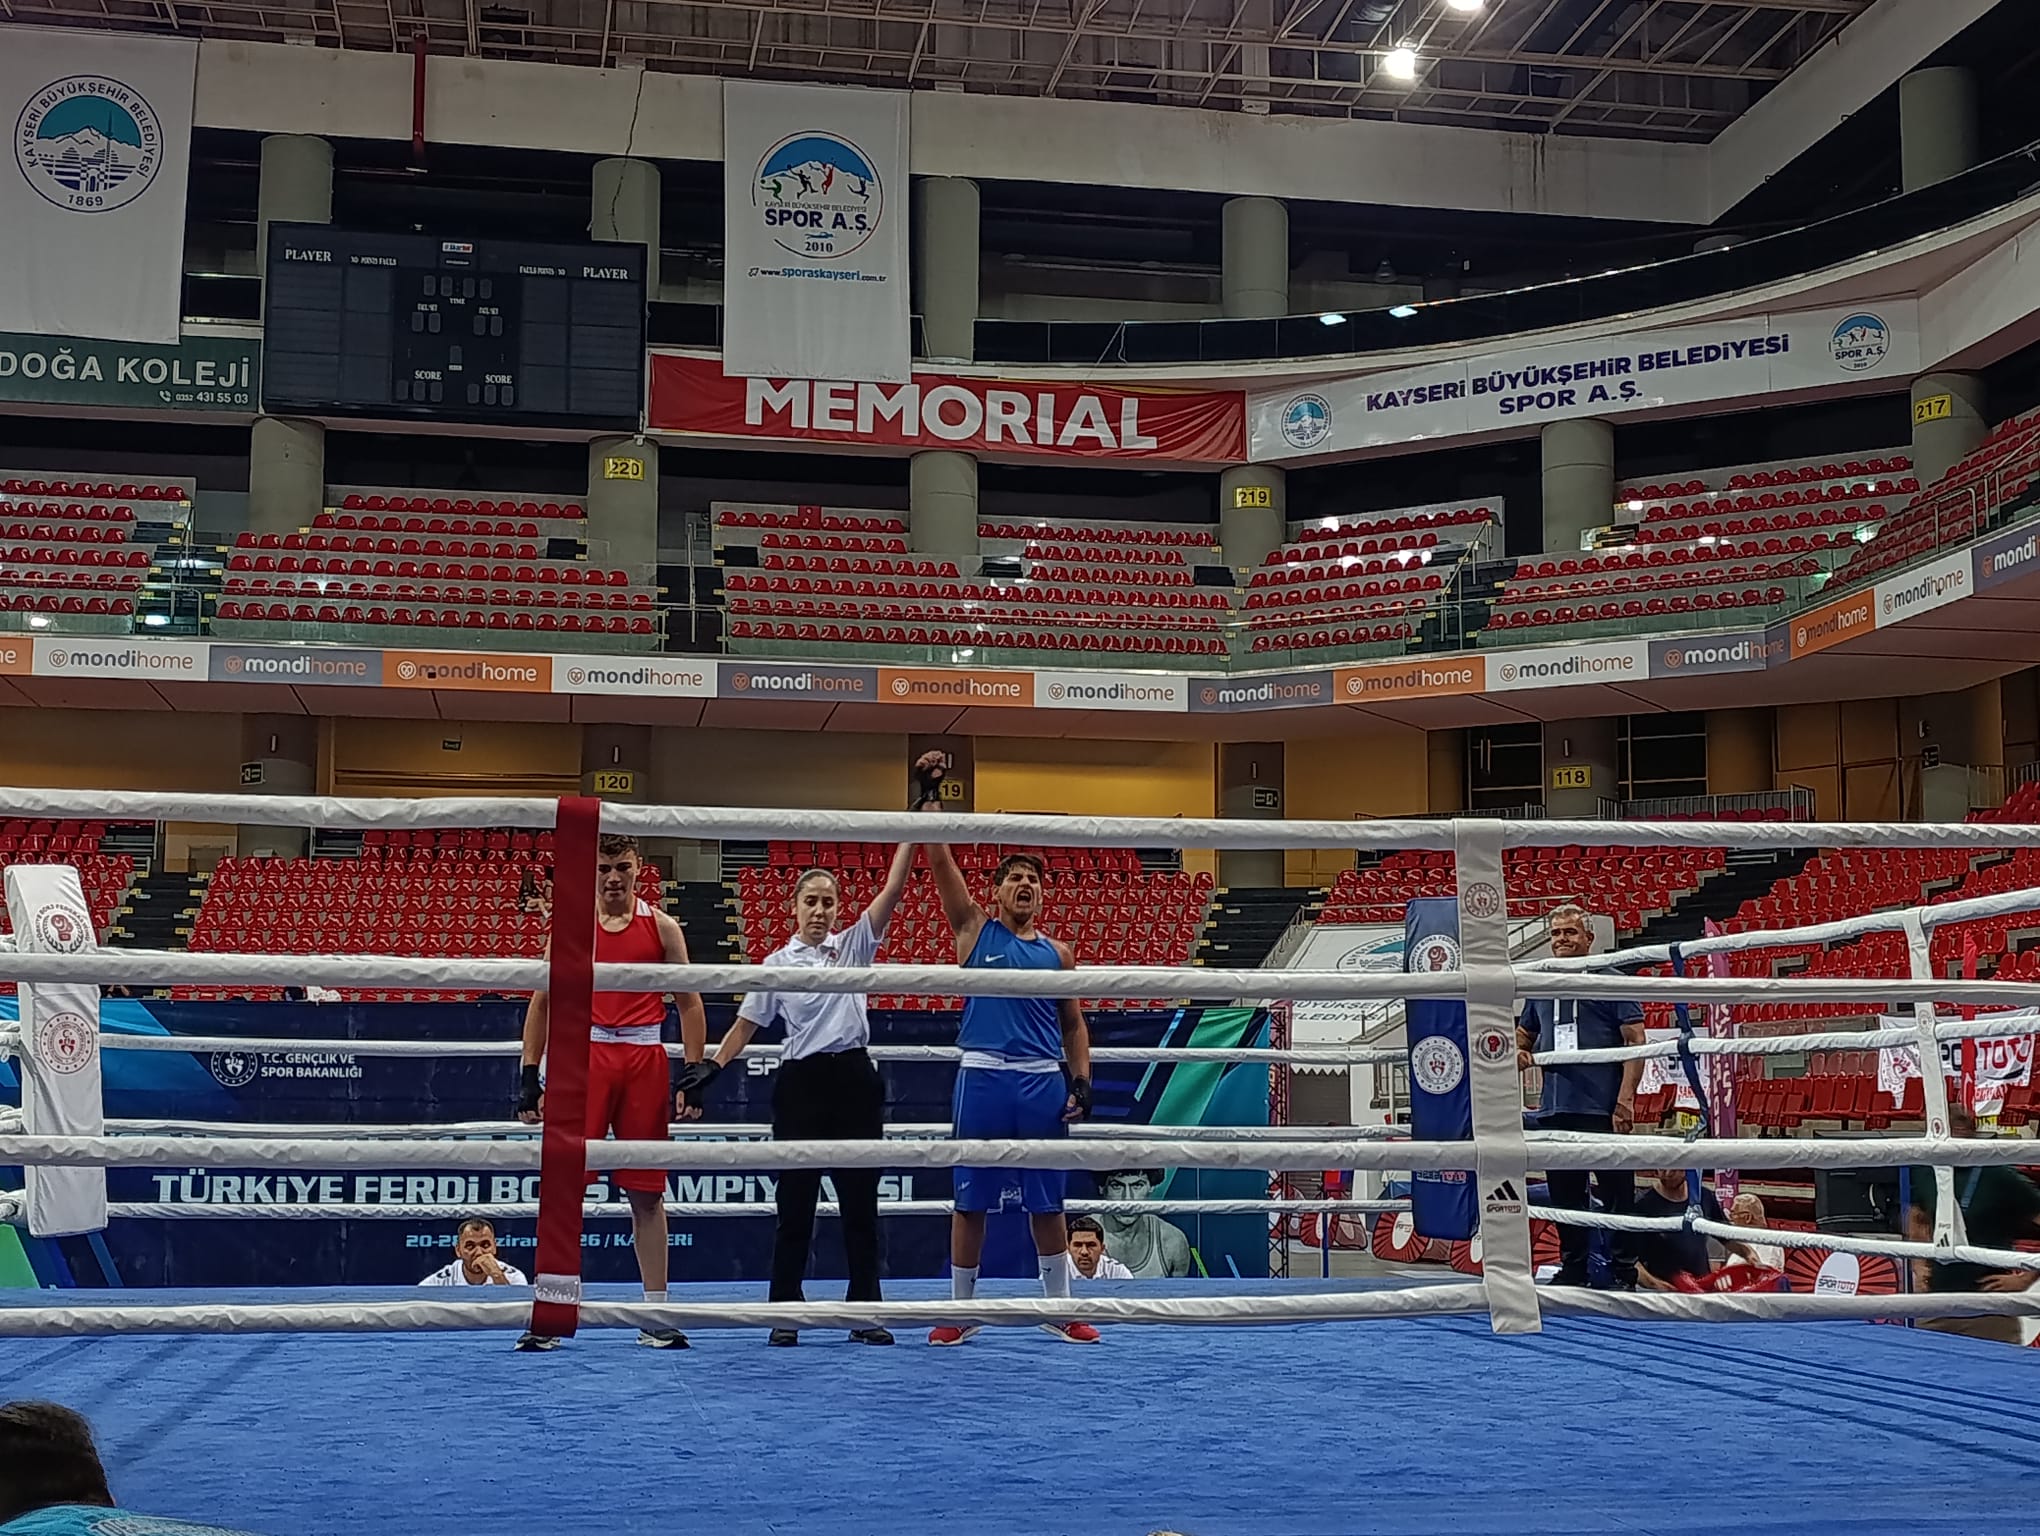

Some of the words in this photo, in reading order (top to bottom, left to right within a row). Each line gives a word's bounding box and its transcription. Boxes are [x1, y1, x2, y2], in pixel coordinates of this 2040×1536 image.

[23, 107, 42, 168] KAYSERİ
[40, 82, 129, 109] BÜYÜKŞEHİR
[130, 102, 157, 178] BELEDİYESİ
[68, 194, 104, 207] 1869
[765, 208, 823, 228] SPOR
[831, 212, 871, 235] A.Ş.
[285, 249, 332, 262] PLAYER
[805, 241, 833, 253] 2010
[583, 266, 628, 279] PLAYER
[760, 267, 887, 282] www.sporaskayseri.com.tr
[1835, 349, 1862, 361] SPOR
[0, 347, 103, 382] DOĞA
[117, 357, 249, 388] KOLEJİ
[414, 370, 442, 380] SCORE
[485, 374, 512, 384] SCORE
[196, 391, 214, 403] 431
[216, 392, 231, 404] 55
[234, 393, 249, 404] 03
[1499, 389, 1577, 415] SPOR
[1588, 379, 1643, 403] A.Ş.
[744, 378, 1158, 450] MEMORIAL
[1916, 399, 1947, 419] 217
[609, 462, 640, 476] 220
[1239, 491, 1267, 503] 219
[1994, 534, 2040, 571] mondi
[1893, 568, 1964, 610] mondihome
[1806, 605, 1868, 641] mondihome
[70, 649, 194, 670] mondihome
[1684, 637, 1785, 665] mondihome
[245, 655, 366, 676] mondihome
[418, 660, 538, 683] mondihome
[1518, 653, 1634, 679] mondihome
[587, 667, 704, 688] mondihome
[749, 672, 864, 692] mondihome
[910, 677, 1022, 698] mondihome
[1365, 668, 1473, 692] mondihome
[1067, 682, 1175, 702] mondihome
[1218, 682, 1321, 704] mondihome
[599, 775, 629, 789] 120
[1556, 770, 1586, 785] 118
[941, 783, 961, 797] 19
[261, 1053, 283, 1064] T.C.
[340, 1053, 356, 1064] VE
[1978, 1033, 2032, 1070] TOTO
[261, 1066, 294, 1078] SPOR
[296, 1065, 363, 1078] BAKANLIĞI
[491, 1176, 609, 1203] BOS
[495, 1234, 538, 1247] zira
[580, 1233, 600, 1247] 26
